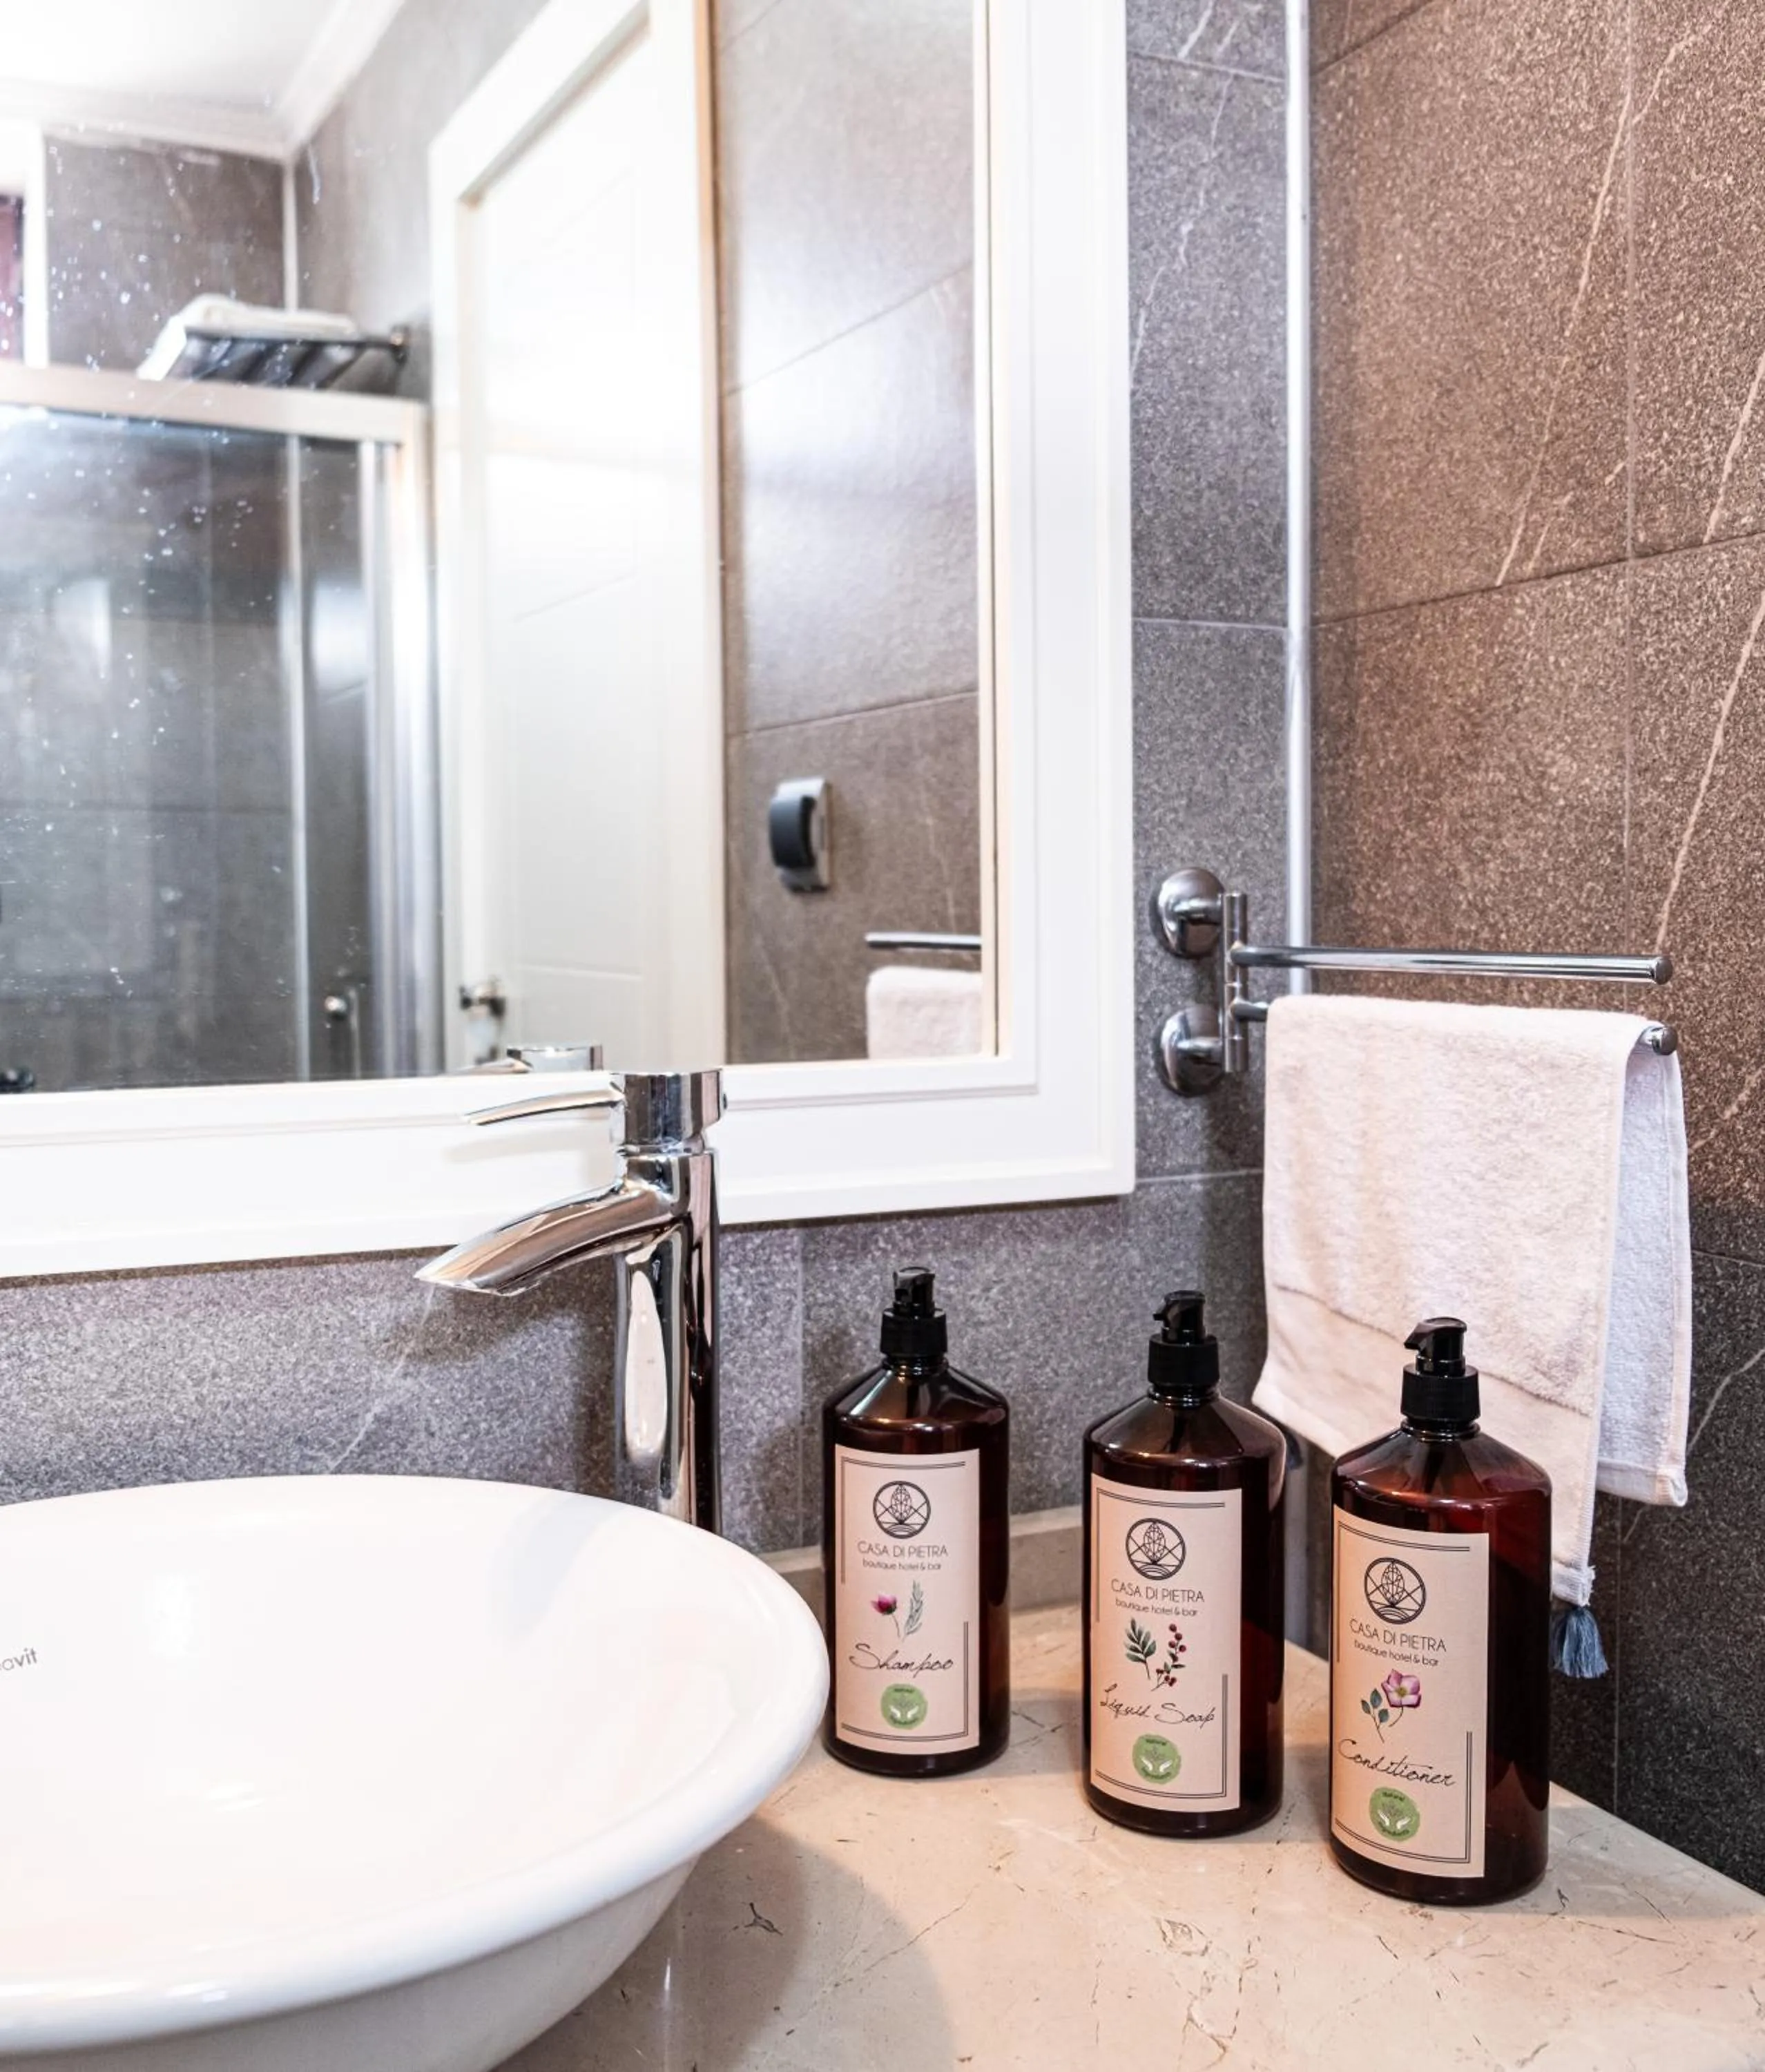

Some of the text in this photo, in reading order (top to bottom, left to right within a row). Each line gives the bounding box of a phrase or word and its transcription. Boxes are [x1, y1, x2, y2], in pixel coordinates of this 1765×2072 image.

[857, 1541, 948, 1558] CASA DI PIETRA
[863, 1558, 897, 1571] boutique
[899, 1560, 919, 1571] hotel
[927, 1560, 941, 1571] bar
[1111, 1579, 1204, 1602] CASA DI PIETRA
[1115, 1598, 1197, 1617] boutique hotel & bar
[1349, 1618, 1447, 1653] CASA DI PIETRA
[0, 1647, 37, 1671] avit
[849, 1643, 954, 1678] Shampoo
[1354, 1639, 1438, 1667] boutique hotel & bar
[1100, 1683, 1216, 1729] Liquid Soap
[1338, 1738, 1456, 1787] Conditioner
